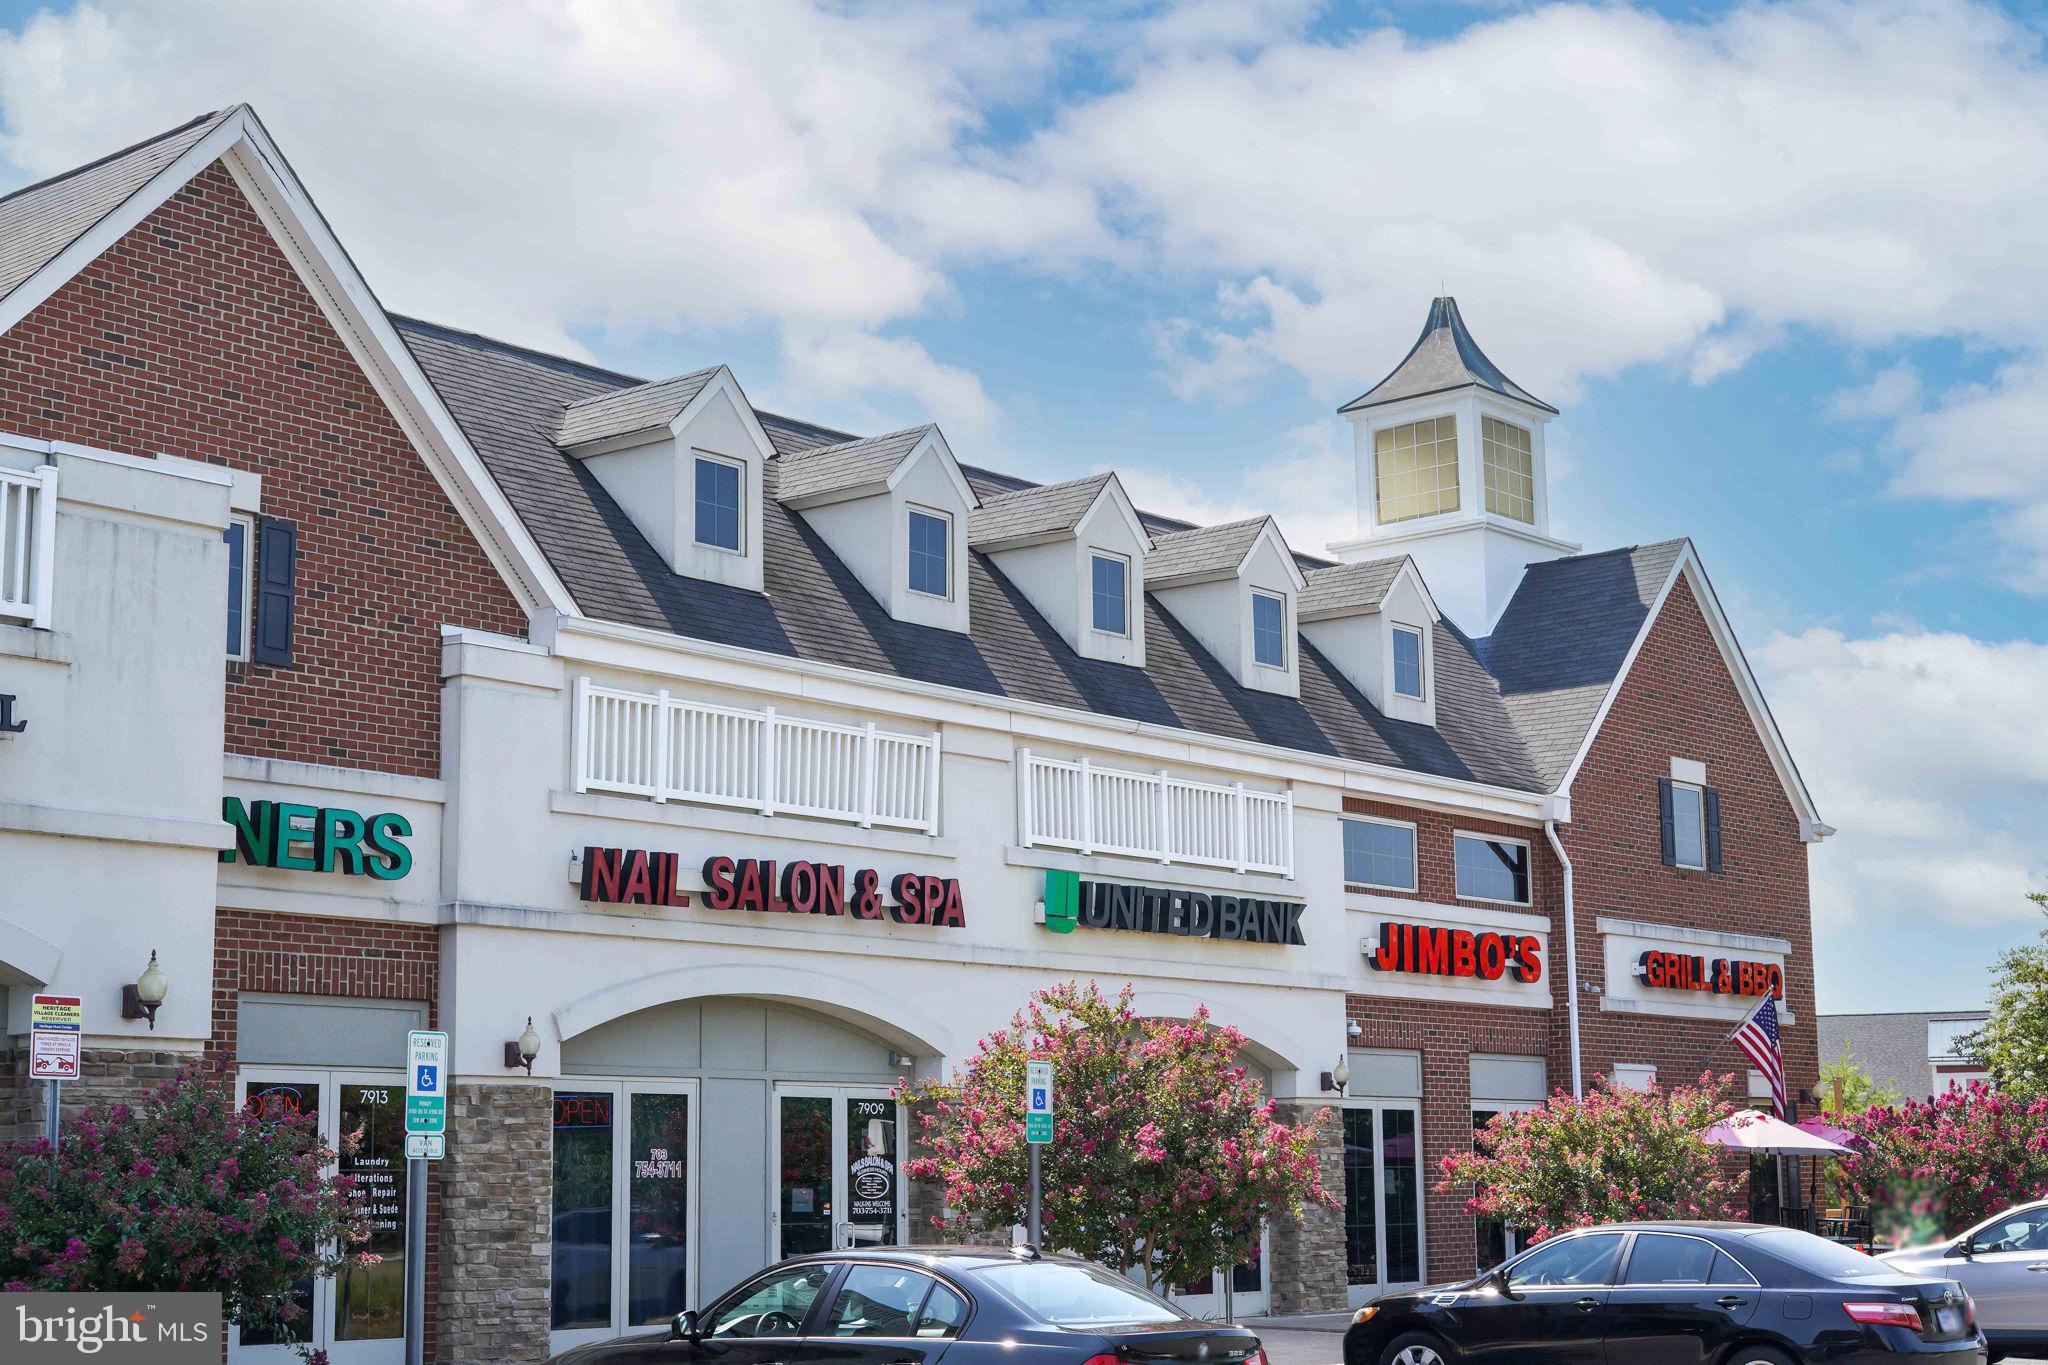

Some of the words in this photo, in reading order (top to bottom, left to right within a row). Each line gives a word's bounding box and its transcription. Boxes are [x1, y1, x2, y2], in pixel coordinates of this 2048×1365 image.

[580, 846, 690, 907] NAIL
[701, 856, 845, 916] SALON
[850, 868, 884, 921] &
[891, 872, 966, 928] SPA
[1079, 880, 1214, 937] UNITED
[1212, 895, 1307, 946] BANK
[1369, 922, 1542, 983] JIMBO'S
[1639, 950, 1713, 992] GRILL
[1710, 958, 1732, 994] &
[1731, 961, 1783, 1001] BBQ
[413, 1037, 442, 1049] RESERVED
[415, 1051, 439, 1062] PARKING
[360, 1090, 388, 1104] 7913
[554, 1099, 609, 1124] OPEN
[858, 1103, 885, 1115] 7909
[651, 1149, 668, 1160] 703
[354, 1158, 389, 1167] Laundry
[635, 1161, 682, 1178] 754-3711
[354, 1173, 393, 1183] lterations
[372, 1188, 397, 1198] Repair
[372, 1204, 378, 1214] &
[379, 1204, 399, 1214] Suede
